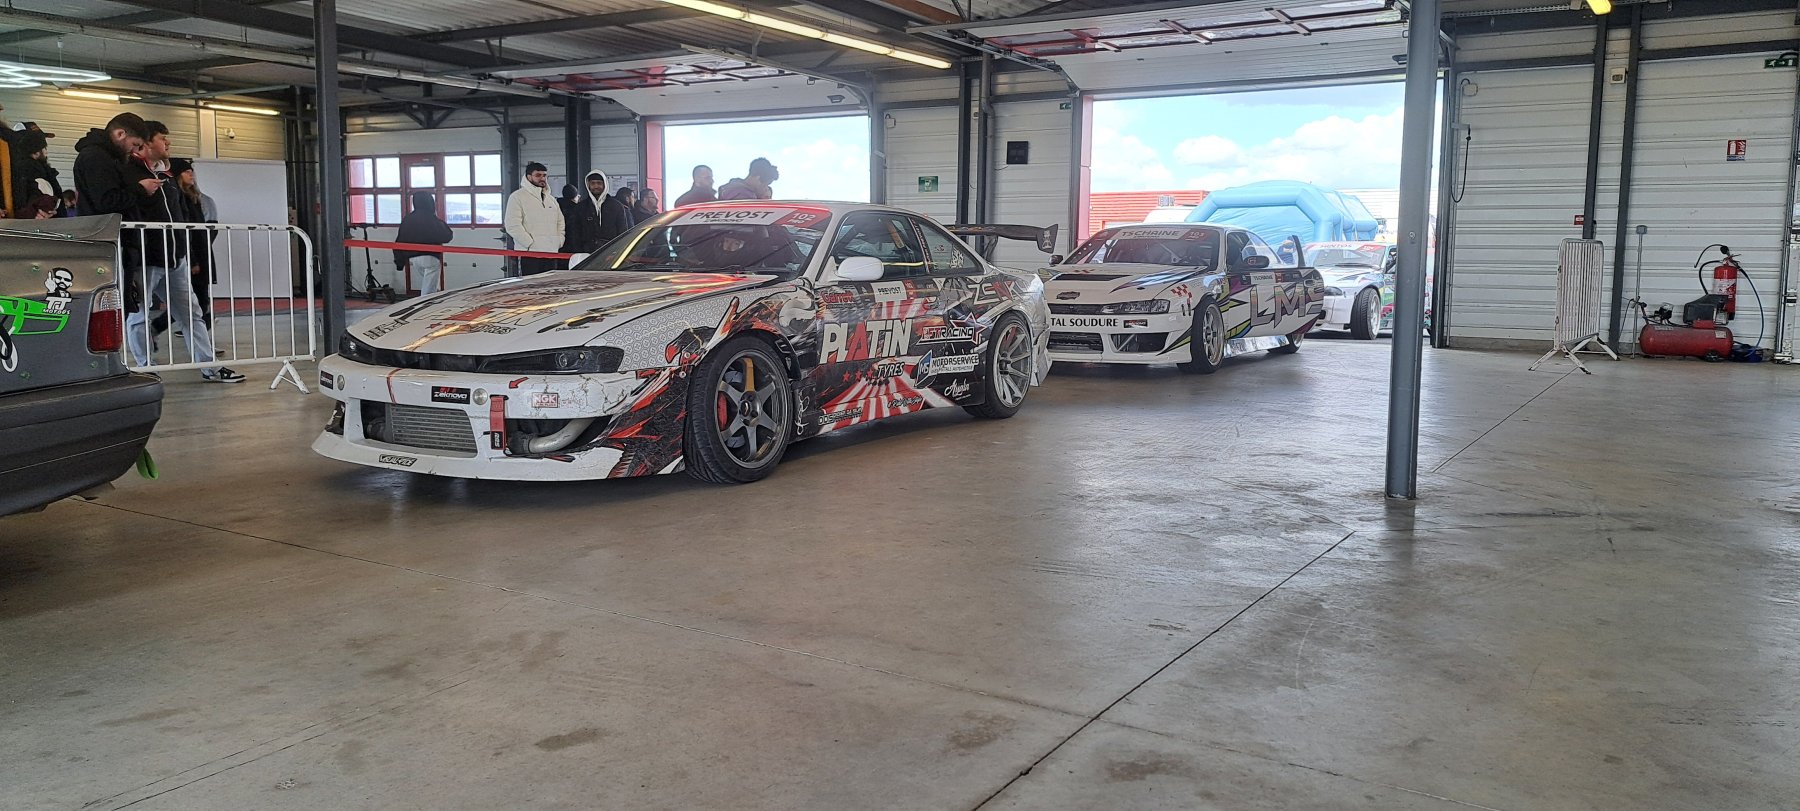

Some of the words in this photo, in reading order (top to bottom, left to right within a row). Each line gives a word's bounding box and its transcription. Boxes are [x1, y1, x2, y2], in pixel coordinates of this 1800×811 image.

[690, 210, 774, 219] PREVOST
[792, 212, 816, 222] 102
[877, 286, 902, 295] PREVOST
[1070, 318, 1119, 327] SOUDURE
[931, 354, 980, 369] MOTORSERVICE
[877, 361, 906, 379] TYRES
[533, 393, 558, 404] NGK
